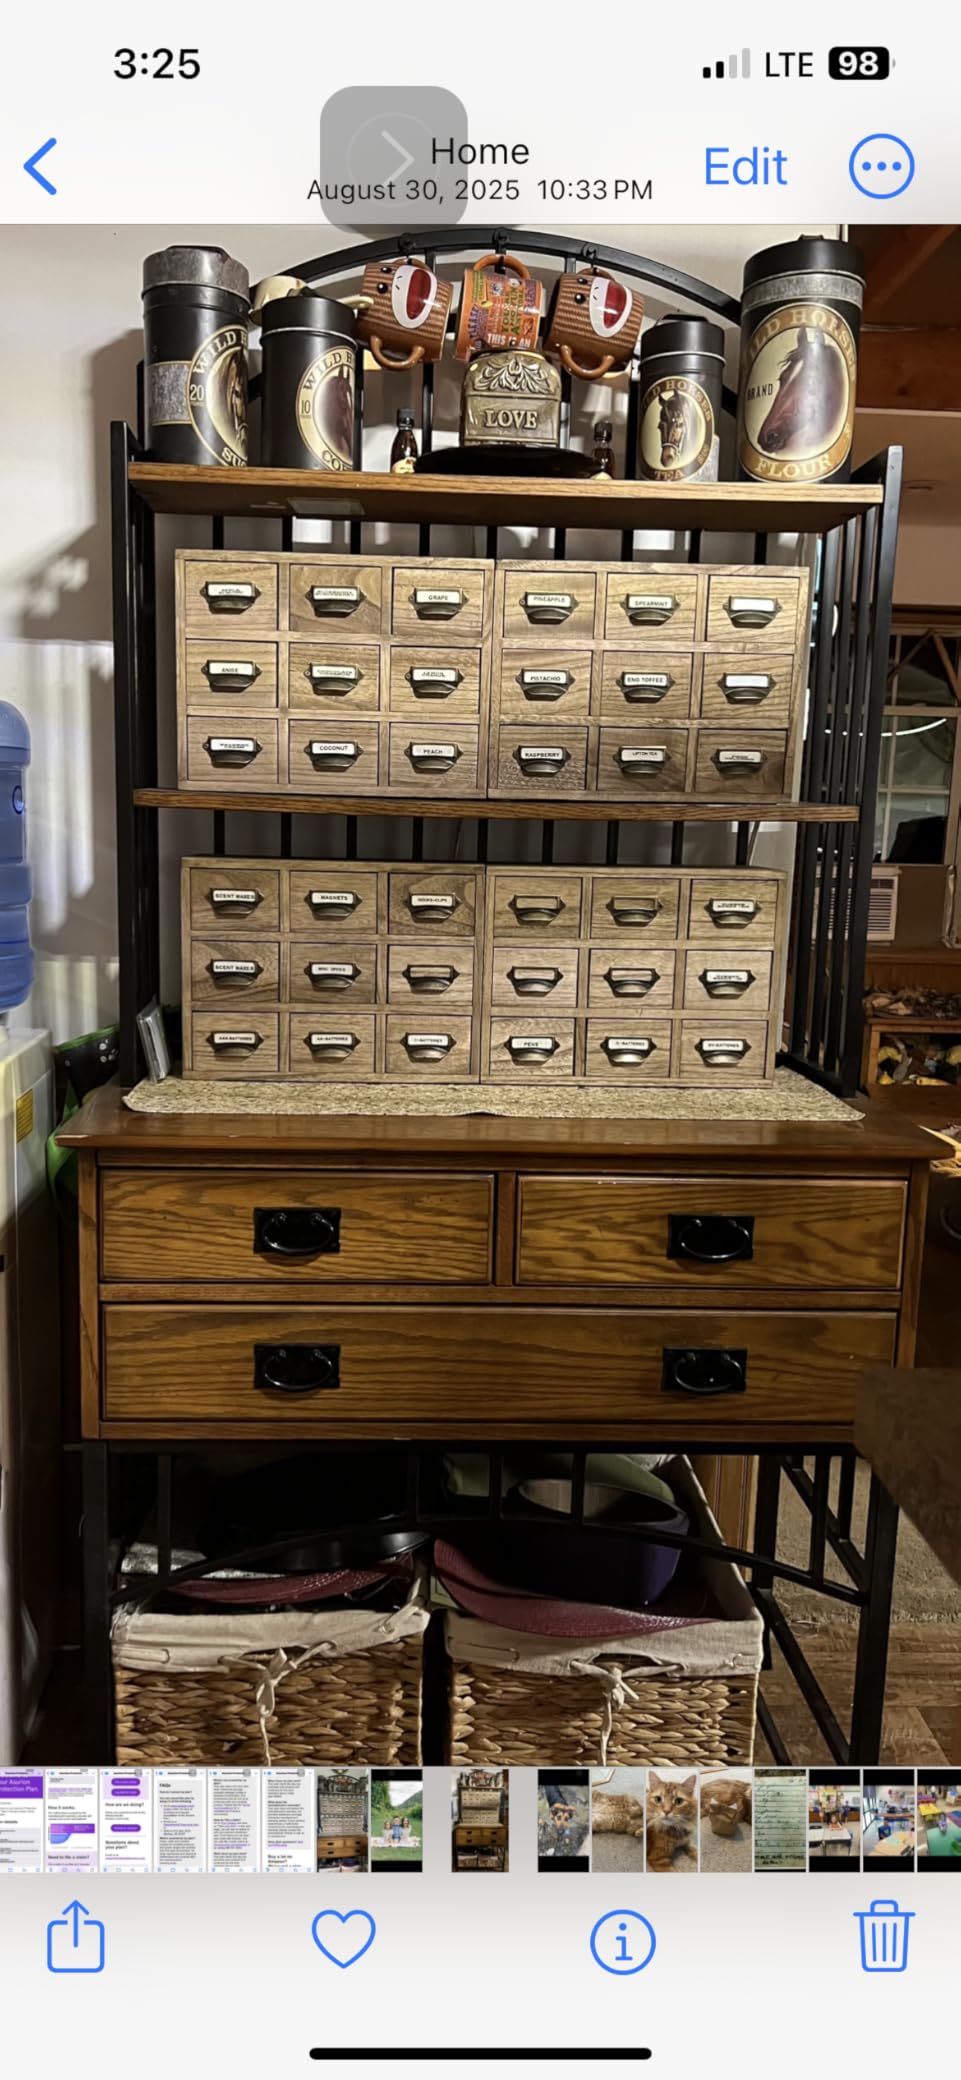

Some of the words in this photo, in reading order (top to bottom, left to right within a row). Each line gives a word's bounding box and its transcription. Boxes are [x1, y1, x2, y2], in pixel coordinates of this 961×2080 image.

[487, 333, 506, 346] THIS
[193, 331, 237, 375] WILD
[303, 352, 342, 391] WILD
[190, 384, 205, 401] 20
[747, 382, 774, 402] BRAND
[301, 400, 311, 414] 10
[484, 408, 539, 430] LOVE
[654, 470, 685, 481] TEA
[755, 453, 833, 479] FLOUR
